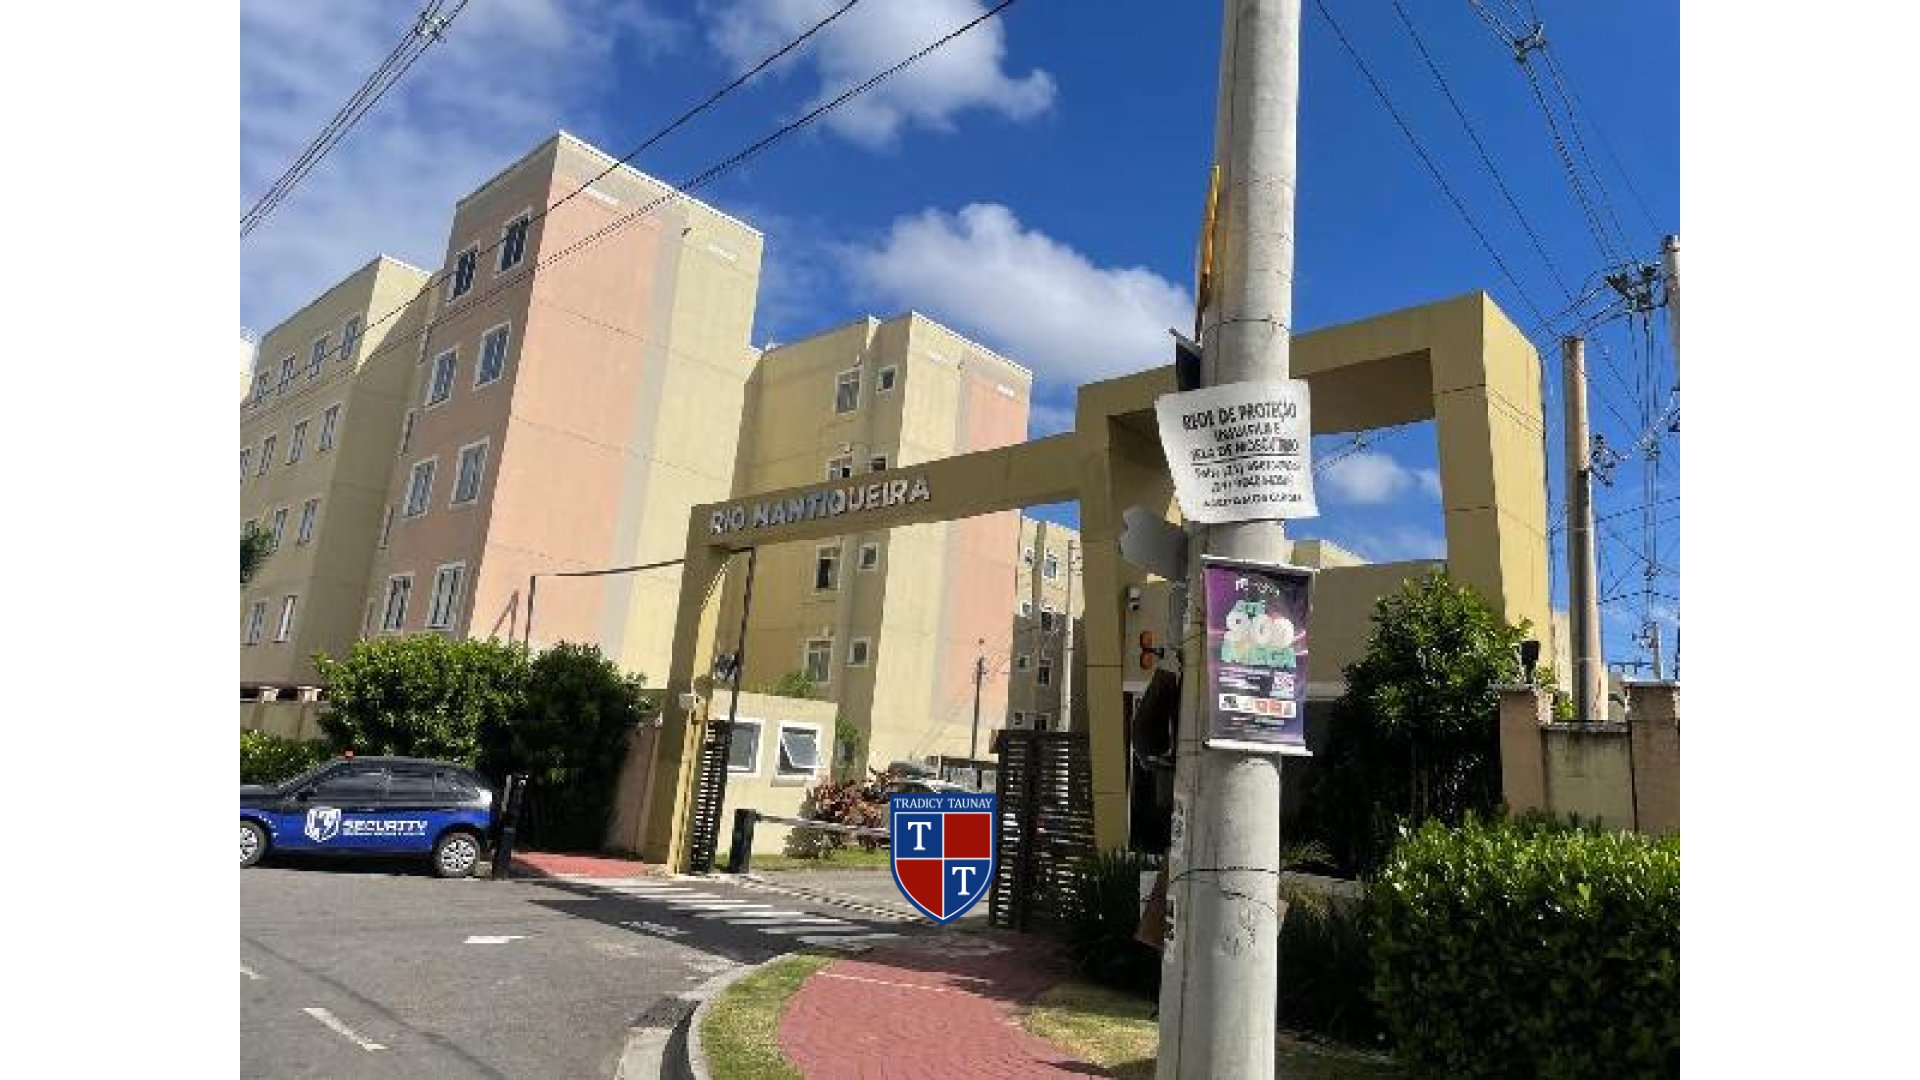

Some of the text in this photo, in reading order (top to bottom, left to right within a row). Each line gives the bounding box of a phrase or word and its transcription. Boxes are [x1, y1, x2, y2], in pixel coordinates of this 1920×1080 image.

[1219, 406, 1236, 425] DE
[710, 478, 931, 535] RIO MANTIQUEIRA
